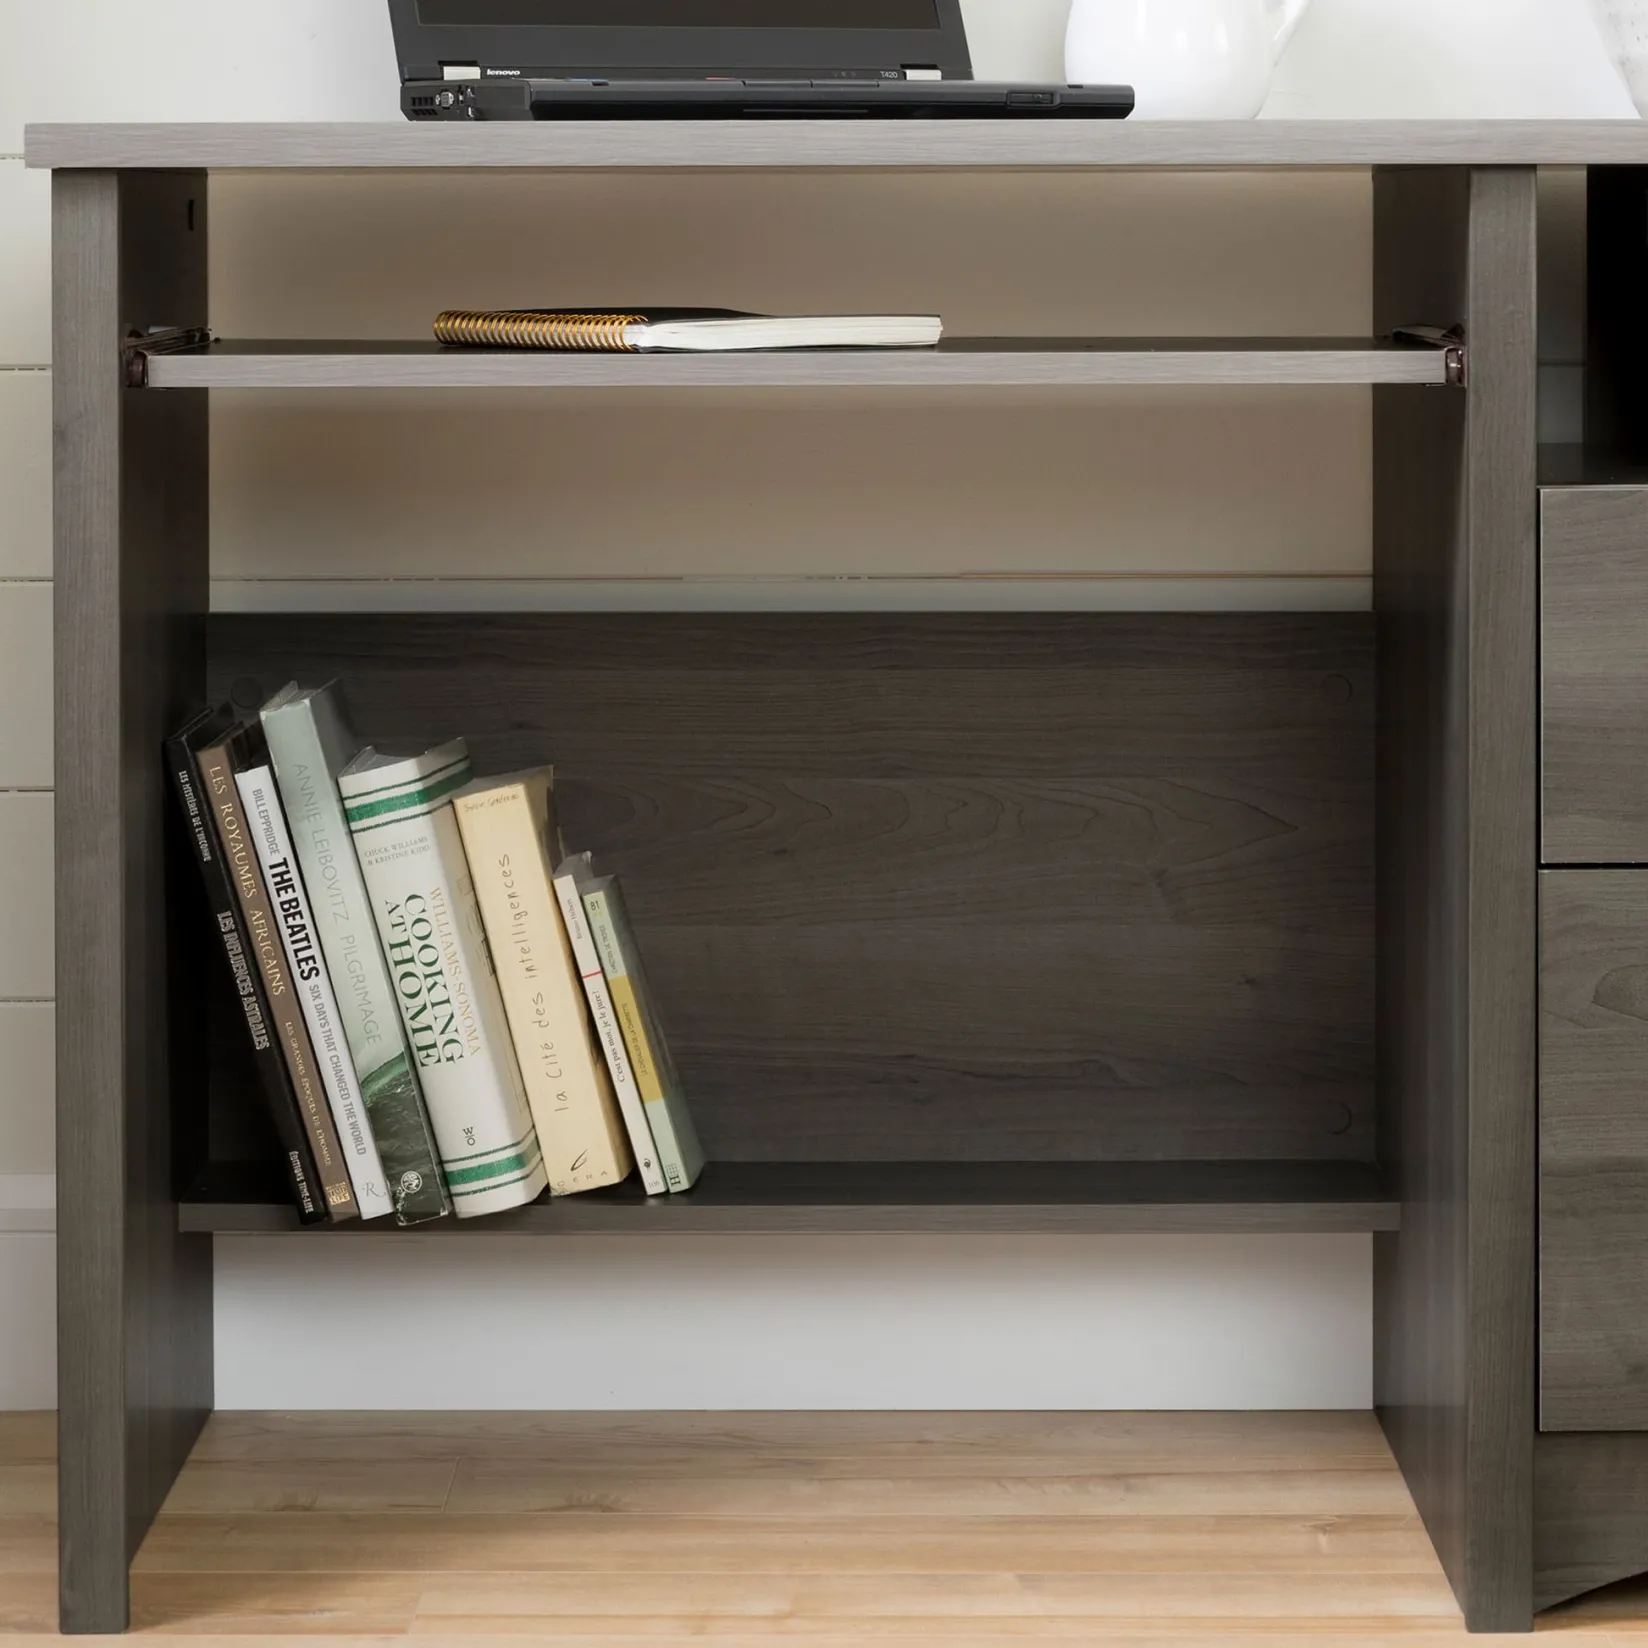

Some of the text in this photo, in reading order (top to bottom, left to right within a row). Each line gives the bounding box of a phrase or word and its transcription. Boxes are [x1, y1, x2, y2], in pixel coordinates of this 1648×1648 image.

[880, 70, 898, 79] T420
[179, 771, 188, 782] LES
[192, 817, 201, 827] DE
[253, 789, 280, 856] BILL EPPRIDGE
[391, 836, 428, 849] WILLIAMS
[209, 766, 285, 995] LES ROYAUMES AFRICAINS
[269, 857, 320, 980] THE BEATLES
[293, 765, 382, 1045] ANNIE LEIBOVITZ PILGRIMAGE
[498, 854, 537, 979] intelligences
[217, 911, 269, 1050] LES INFLUENCES ASTRALES
[385, 900, 442, 1067] AT HOME
[405, 894, 464, 1065] COOKING
[430, 886, 482, 1057] WILLIAMS-SONOMA
[532, 991, 549, 1028] des
[285, 1022, 294, 1035] LES
[312, 1116, 320, 1126] DE
[309, 984, 366, 1155] SIX DAYS THAT CHANGED THE WORLD
[540, 1042, 562, 1078] Cité
[612, 1048, 621, 1061] pas
